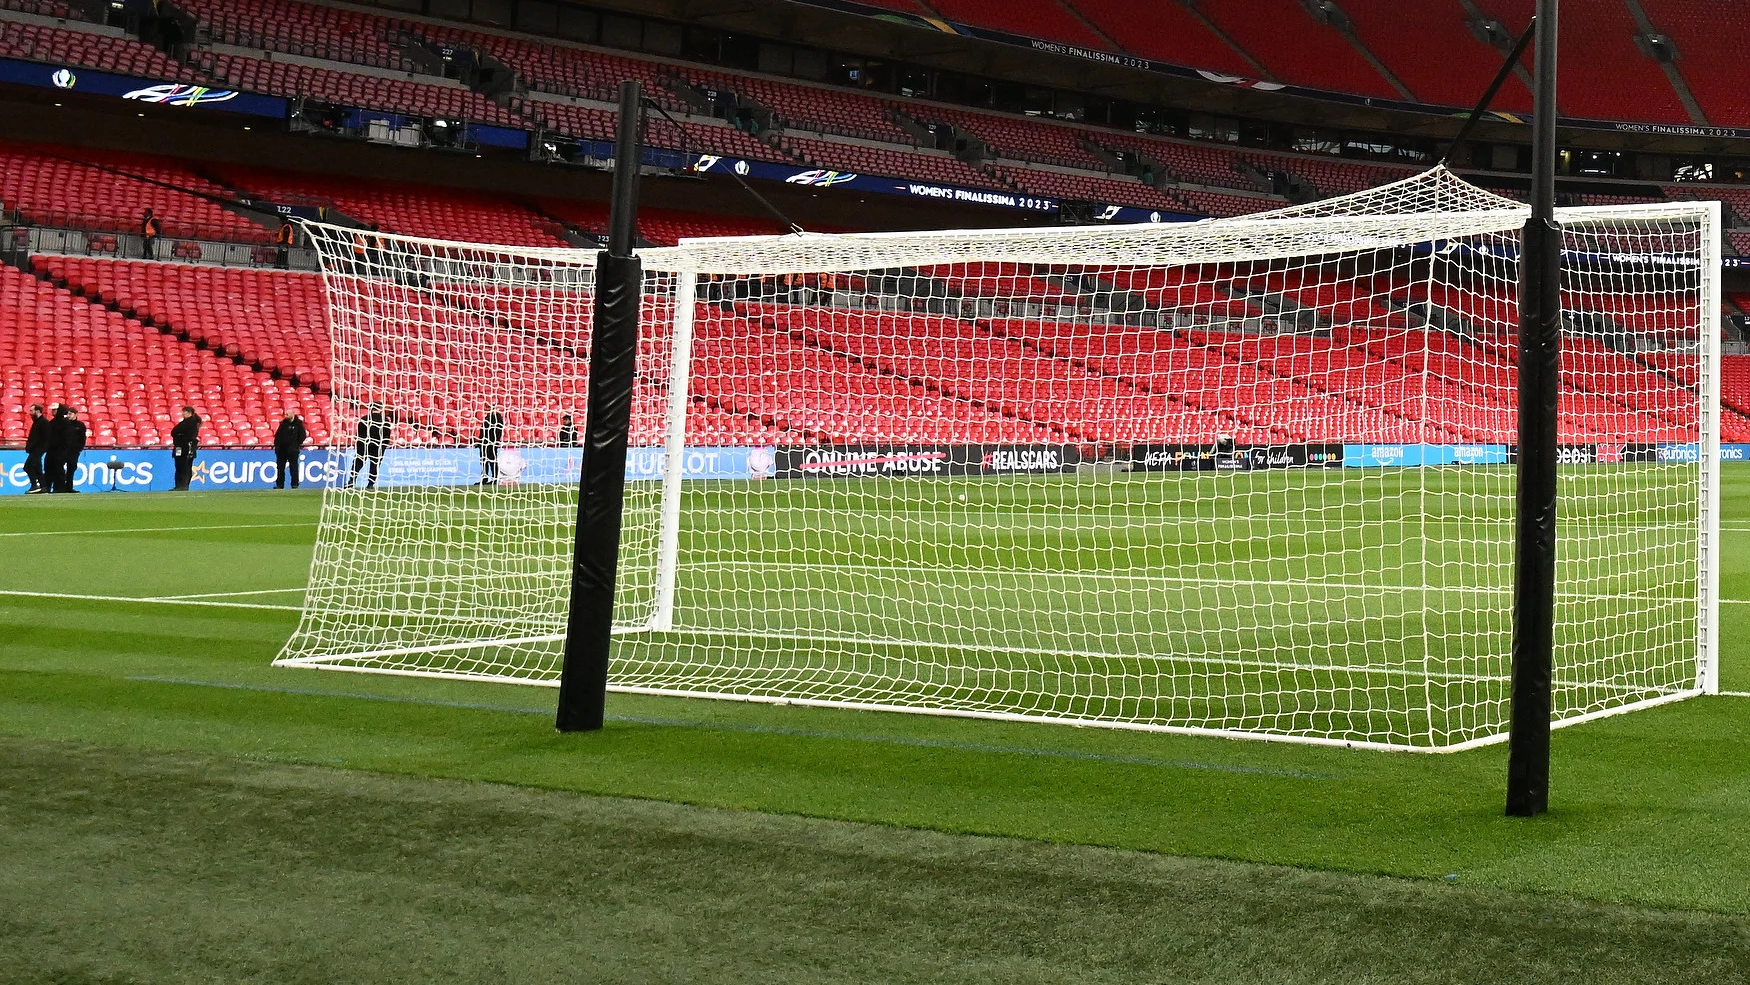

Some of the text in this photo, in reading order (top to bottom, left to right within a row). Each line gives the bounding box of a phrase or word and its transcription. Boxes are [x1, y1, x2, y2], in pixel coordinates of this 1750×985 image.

[442, 48, 454, 56] 227
[1031, 39, 1150, 69] WOMEN'S FINALISSIMA 2023
[1615, 123, 1736, 136] WOMEN'S FINALISSIMA 2023
[909, 184, 1050, 210] WOMEN'S FINALISSIMA 2023
[277, 205, 292, 214] 122
[1612, 254, 1650, 263] WOMEN'S
[1266, 451, 1294, 465] children
[1370, 446, 1404, 458] amazon
[1453, 444, 1484, 458] amazon
[1662, 445, 1698, 460] euronics
[626, 451, 719, 474] HUBOT
[804, 451, 942, 473] ONLINE ABUSE
[981, 449, 1058, 471] #REALSCARS
[8, 455, 153, 486] eonics
[209, 456, 338, 484] euroics
